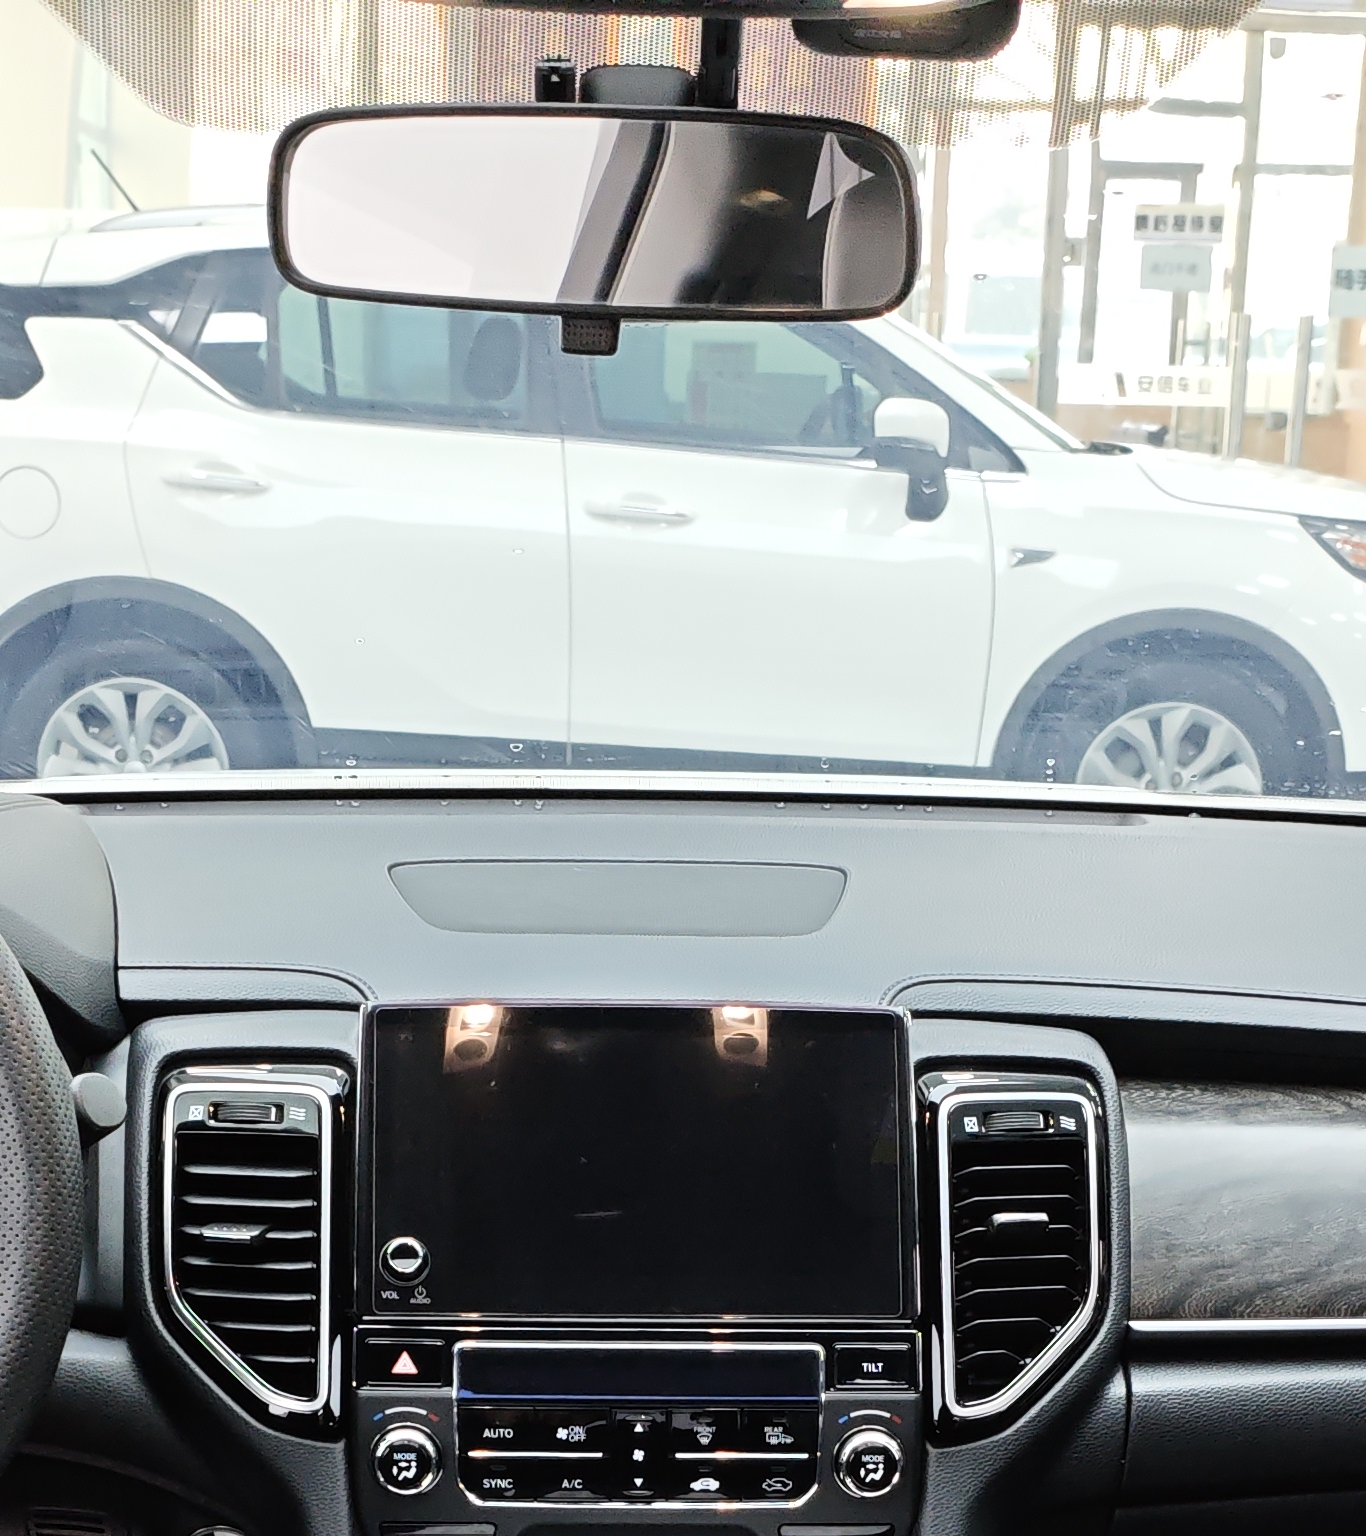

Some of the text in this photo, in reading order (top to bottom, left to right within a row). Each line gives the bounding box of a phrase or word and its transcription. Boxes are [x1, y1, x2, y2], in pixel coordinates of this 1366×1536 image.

[380, 1290, 400, 1299] VOL
[861, 1361, 884, 1372] TILT
[482, 1428, 514, 1439] AUTO
[568, 1434, 587, 1443] OFF
[393, 1452, 417, 1461] MODE
[861, 1454, 885, 1463] MODE
[482, 1478, 514, 1489] SYNC
[561, 1478, 584, 1489] A/C
